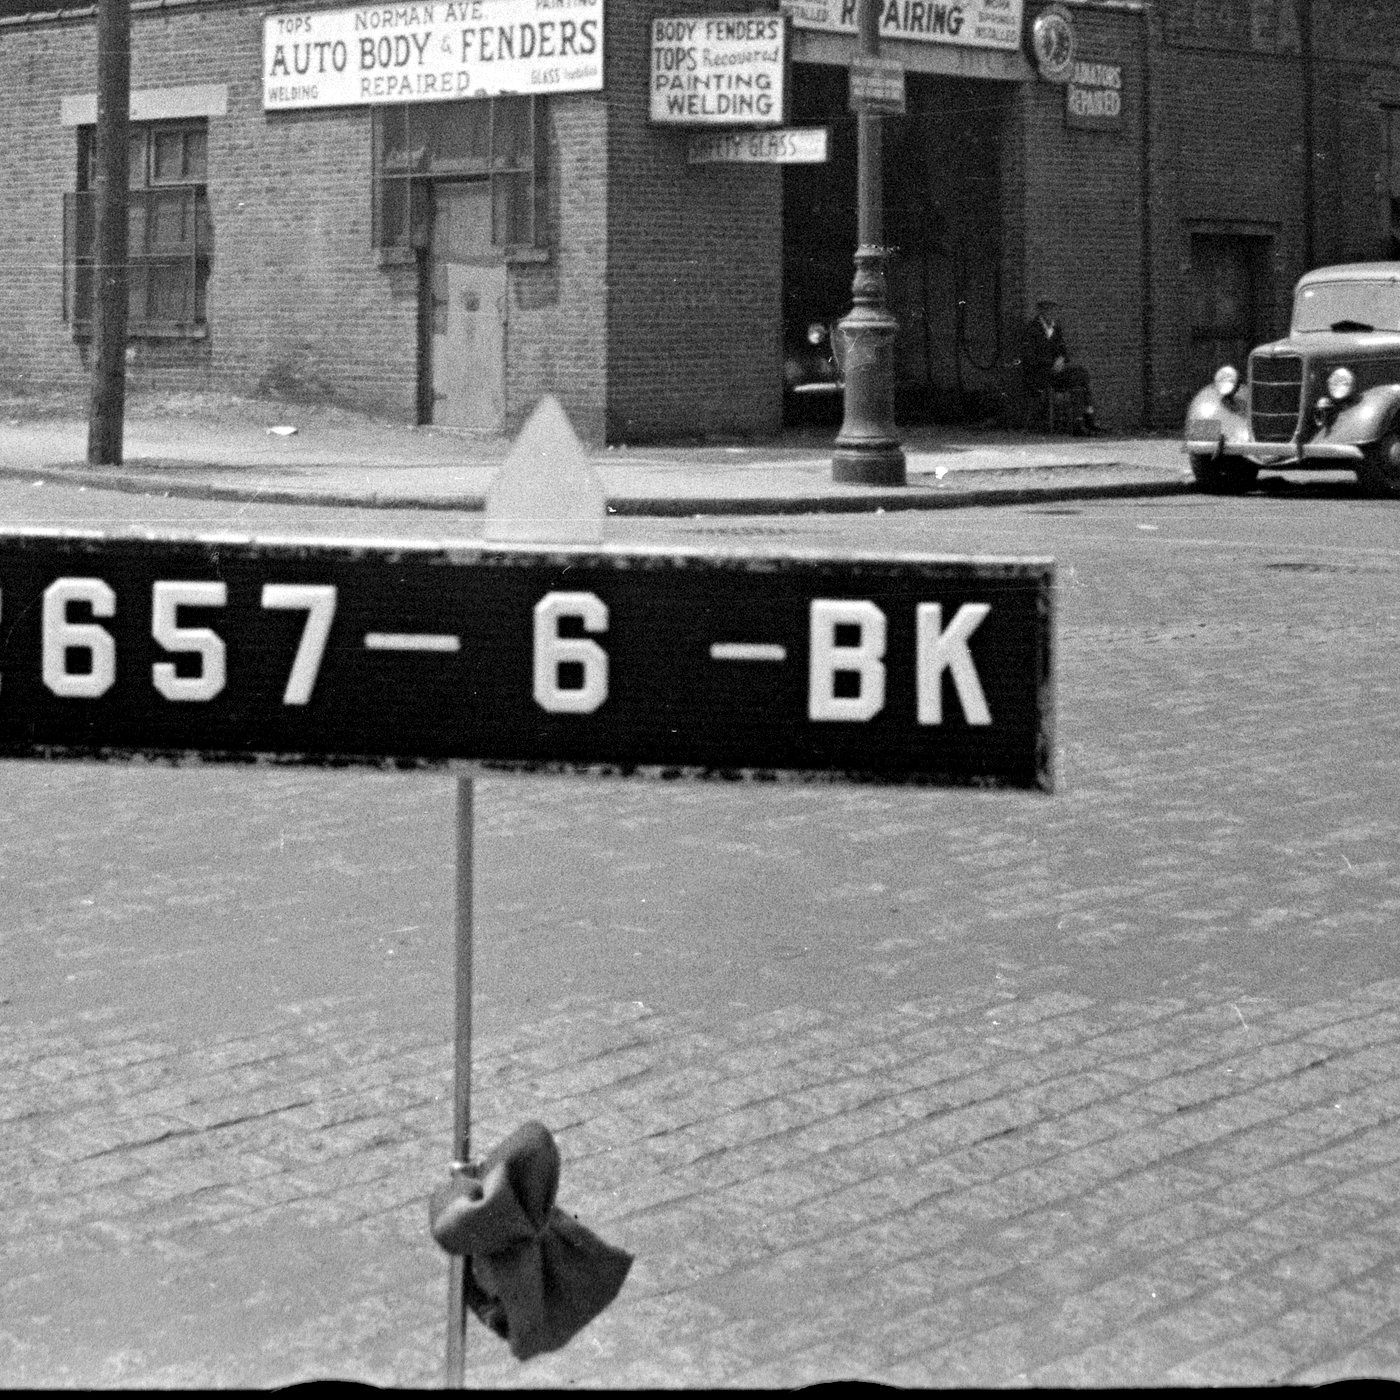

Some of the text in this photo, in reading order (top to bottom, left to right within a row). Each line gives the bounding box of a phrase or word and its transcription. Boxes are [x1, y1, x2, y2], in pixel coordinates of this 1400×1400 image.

[277, 16, 312, 34] TOPS
[355, 5, 434, 31] NORMAN
[656, 20, 779, 41] BODY FENDERS
[269, 40, 347, 76] AUTO
[358, 32, 432, 70] BODY
[461, 19, 598, 63] FENDERS
[654, 47, 697, 71] TOPS
[267, 85, 319, 102] WELDING
[360, 71, 471, 98] REPAIRED
[656, 74, 771, 90] PAINTING
[667, 93, 774, 116] WELDING
[749, 133, 797, 157] GLASS
